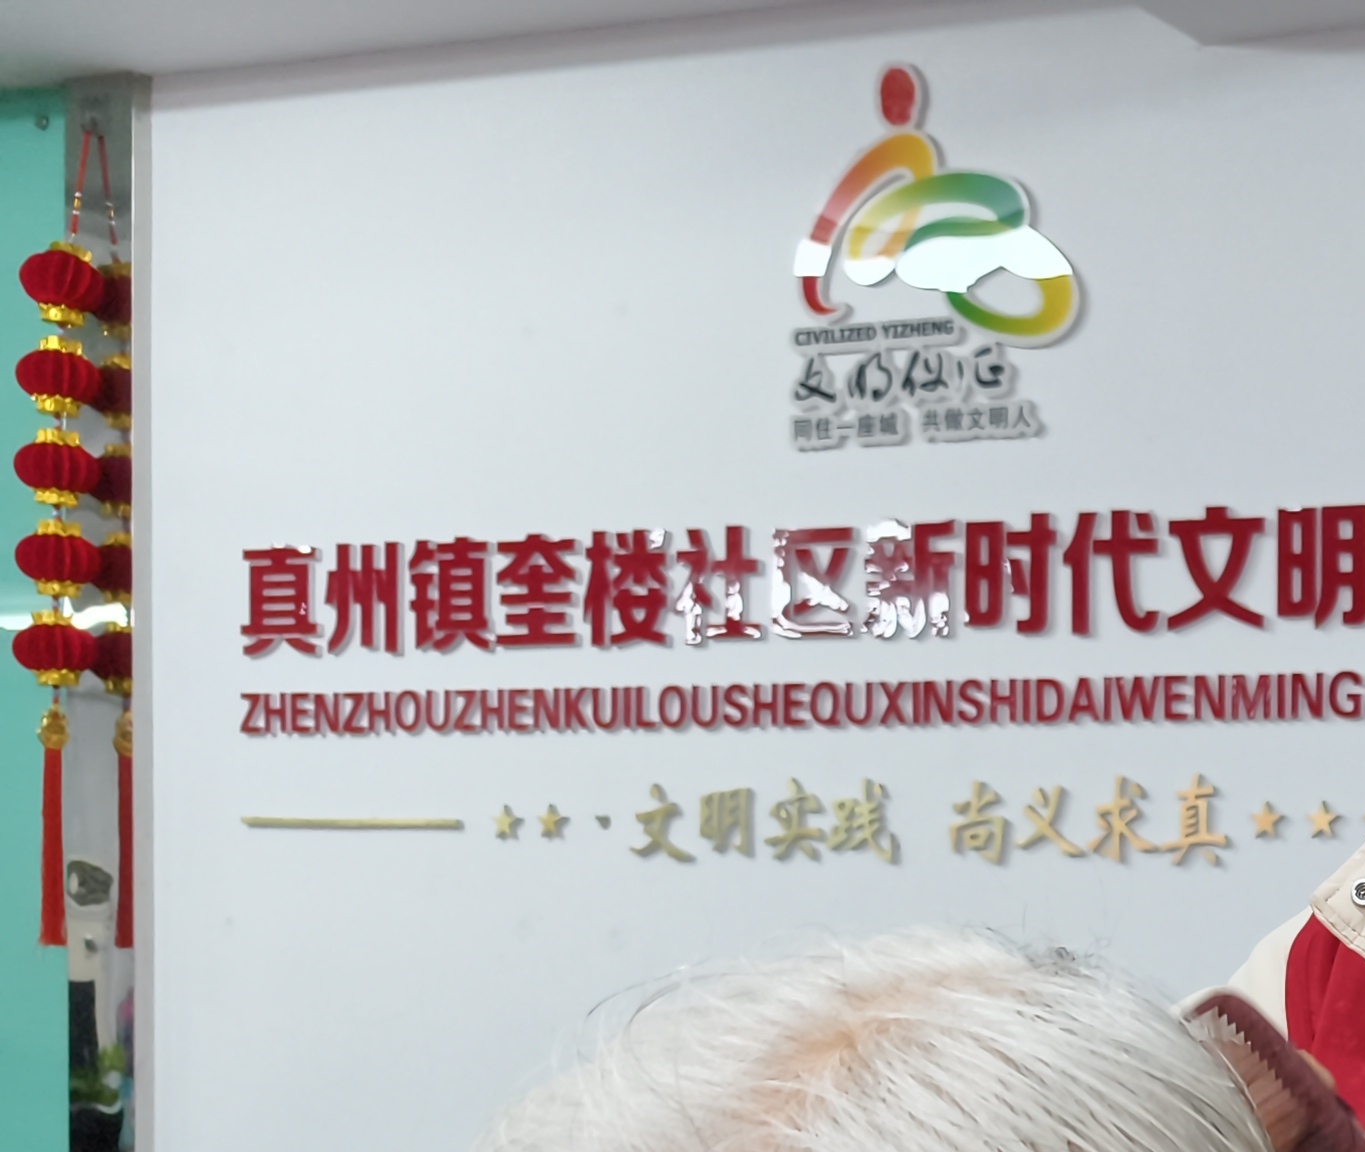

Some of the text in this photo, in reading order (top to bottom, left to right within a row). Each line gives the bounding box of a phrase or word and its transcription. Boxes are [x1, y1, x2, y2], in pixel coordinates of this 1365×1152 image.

[795, 320, 954, 347] CIVILIZED YIZHENG
[629, 771, 1228, 865] 文明实践 尚义求真
